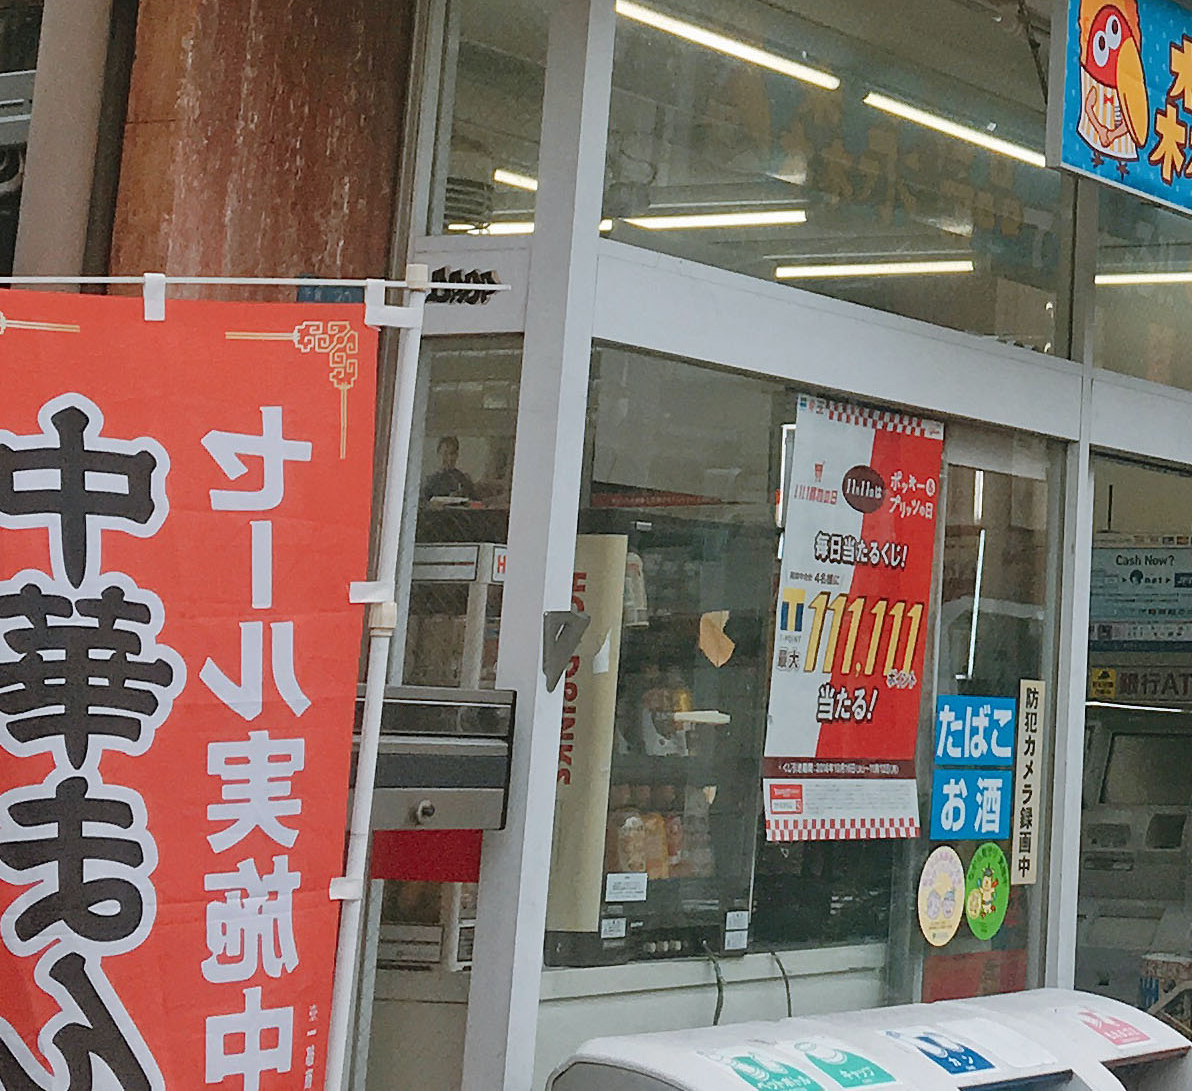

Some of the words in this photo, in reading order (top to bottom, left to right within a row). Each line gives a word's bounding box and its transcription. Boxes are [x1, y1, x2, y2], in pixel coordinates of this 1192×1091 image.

[1116, 554, 1142, 566] Cash
[1144, 555, 1176, 567] Now?
[777, 647, 800, 671] 最大
[816, 682, 878, 724] 当たる!
[936, 704, 1013, 760] たばこ
[940, 777, 1003, 834] お酒
[1018, 686, 1041, 878] 防犯カメラ録画中
